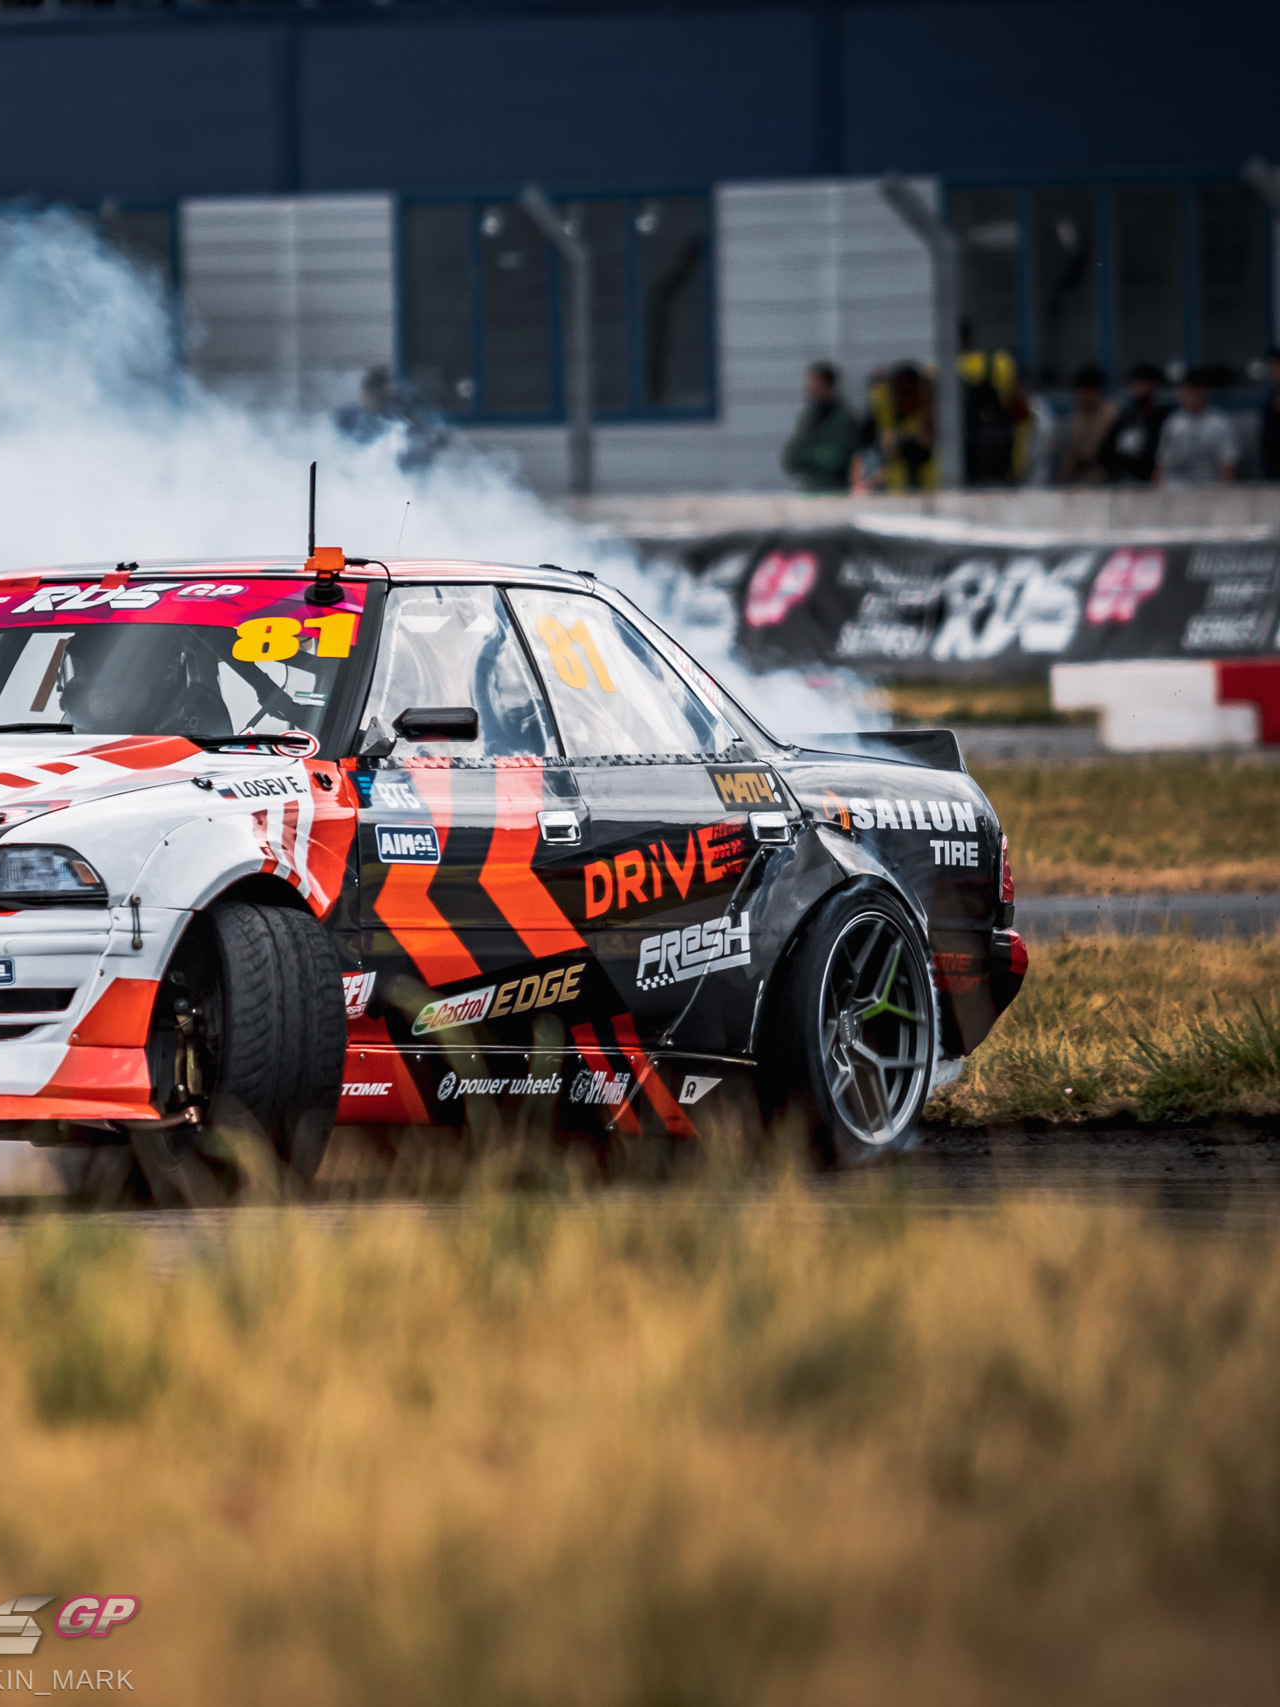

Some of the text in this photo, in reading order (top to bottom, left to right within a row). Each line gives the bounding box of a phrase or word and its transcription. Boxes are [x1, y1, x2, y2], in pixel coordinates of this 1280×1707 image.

[11, 582, 248, 613] RDS GP
[232, 613, 356, 662] 81
[535, 616, 617, 693] 81
[235, 776, 308, 798] LOSEV E.
[848, 798, 978, 833] SAILUN
[381, 833, 437, 856] AIMOL
[929, 839, 979, 867] TIRE
[583, 820, 744, 920] DRIVE
[429, 963, 587, 1030] Castrol EDGE
[340, 1082, 393, 1096] TOMIC
[454, 1073, 563, 1100] power wheels
